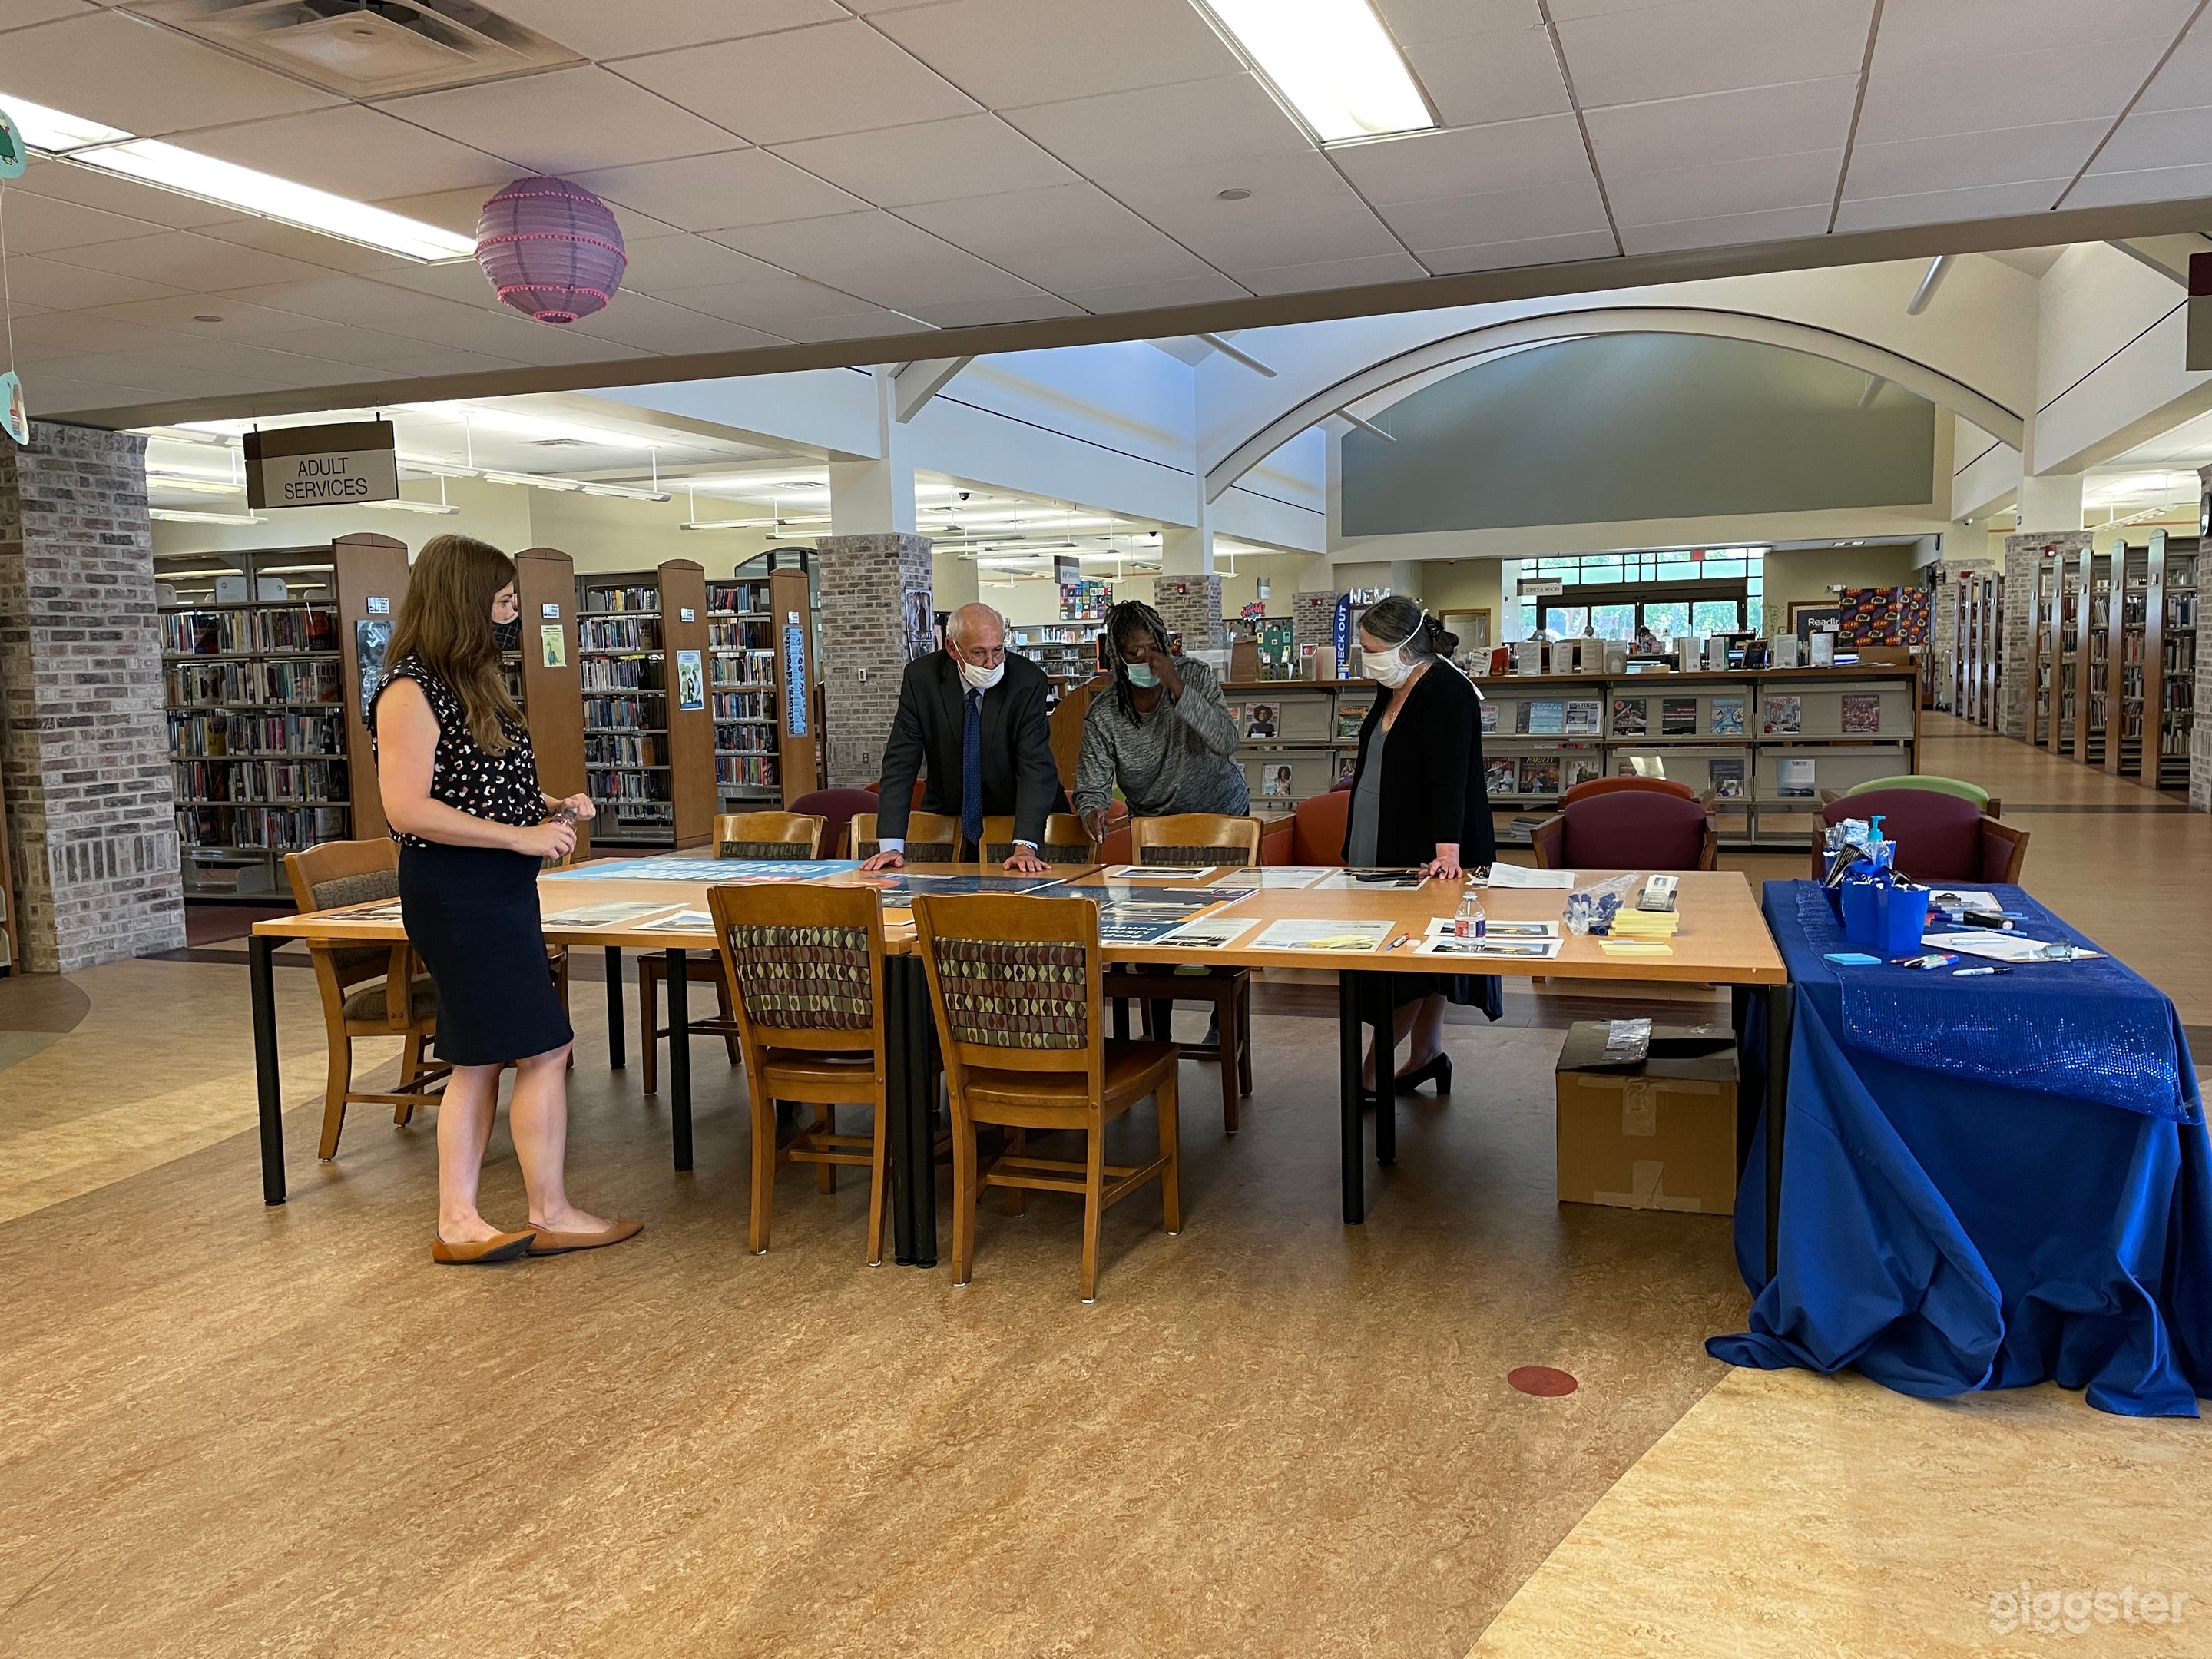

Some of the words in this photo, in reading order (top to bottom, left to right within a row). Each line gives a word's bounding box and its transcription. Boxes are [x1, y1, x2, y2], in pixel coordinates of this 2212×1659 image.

[298, 457, 349, 477] ADULT
[284, 478, 368, 500] SERVICES
[1349, 586, 1392, 605] NEW
[1338, 604, 1346, 631] OUT
[1337, 634, 1346, 667] HECK
